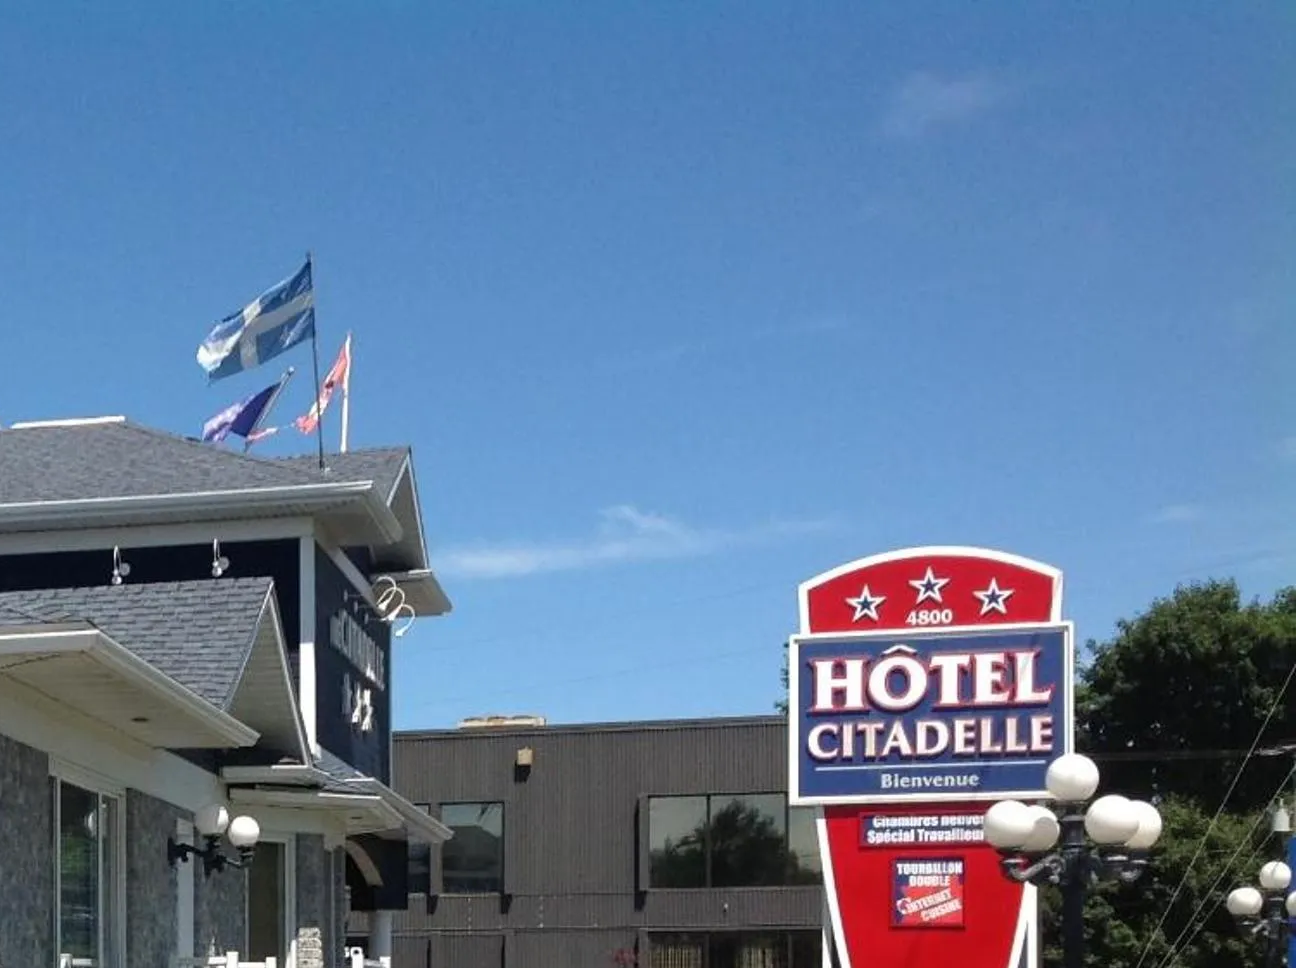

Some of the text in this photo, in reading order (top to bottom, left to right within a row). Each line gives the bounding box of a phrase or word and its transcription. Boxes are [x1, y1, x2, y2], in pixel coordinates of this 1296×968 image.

[905, 609, 953, 626] 4800
[808, 644, 1055, 712] HÔTEL
[807, 717, 1053, 760] CITADELLE
[881, 773, 979, 789] Bienvenue
[867, 828, 915, 844] Spécial
